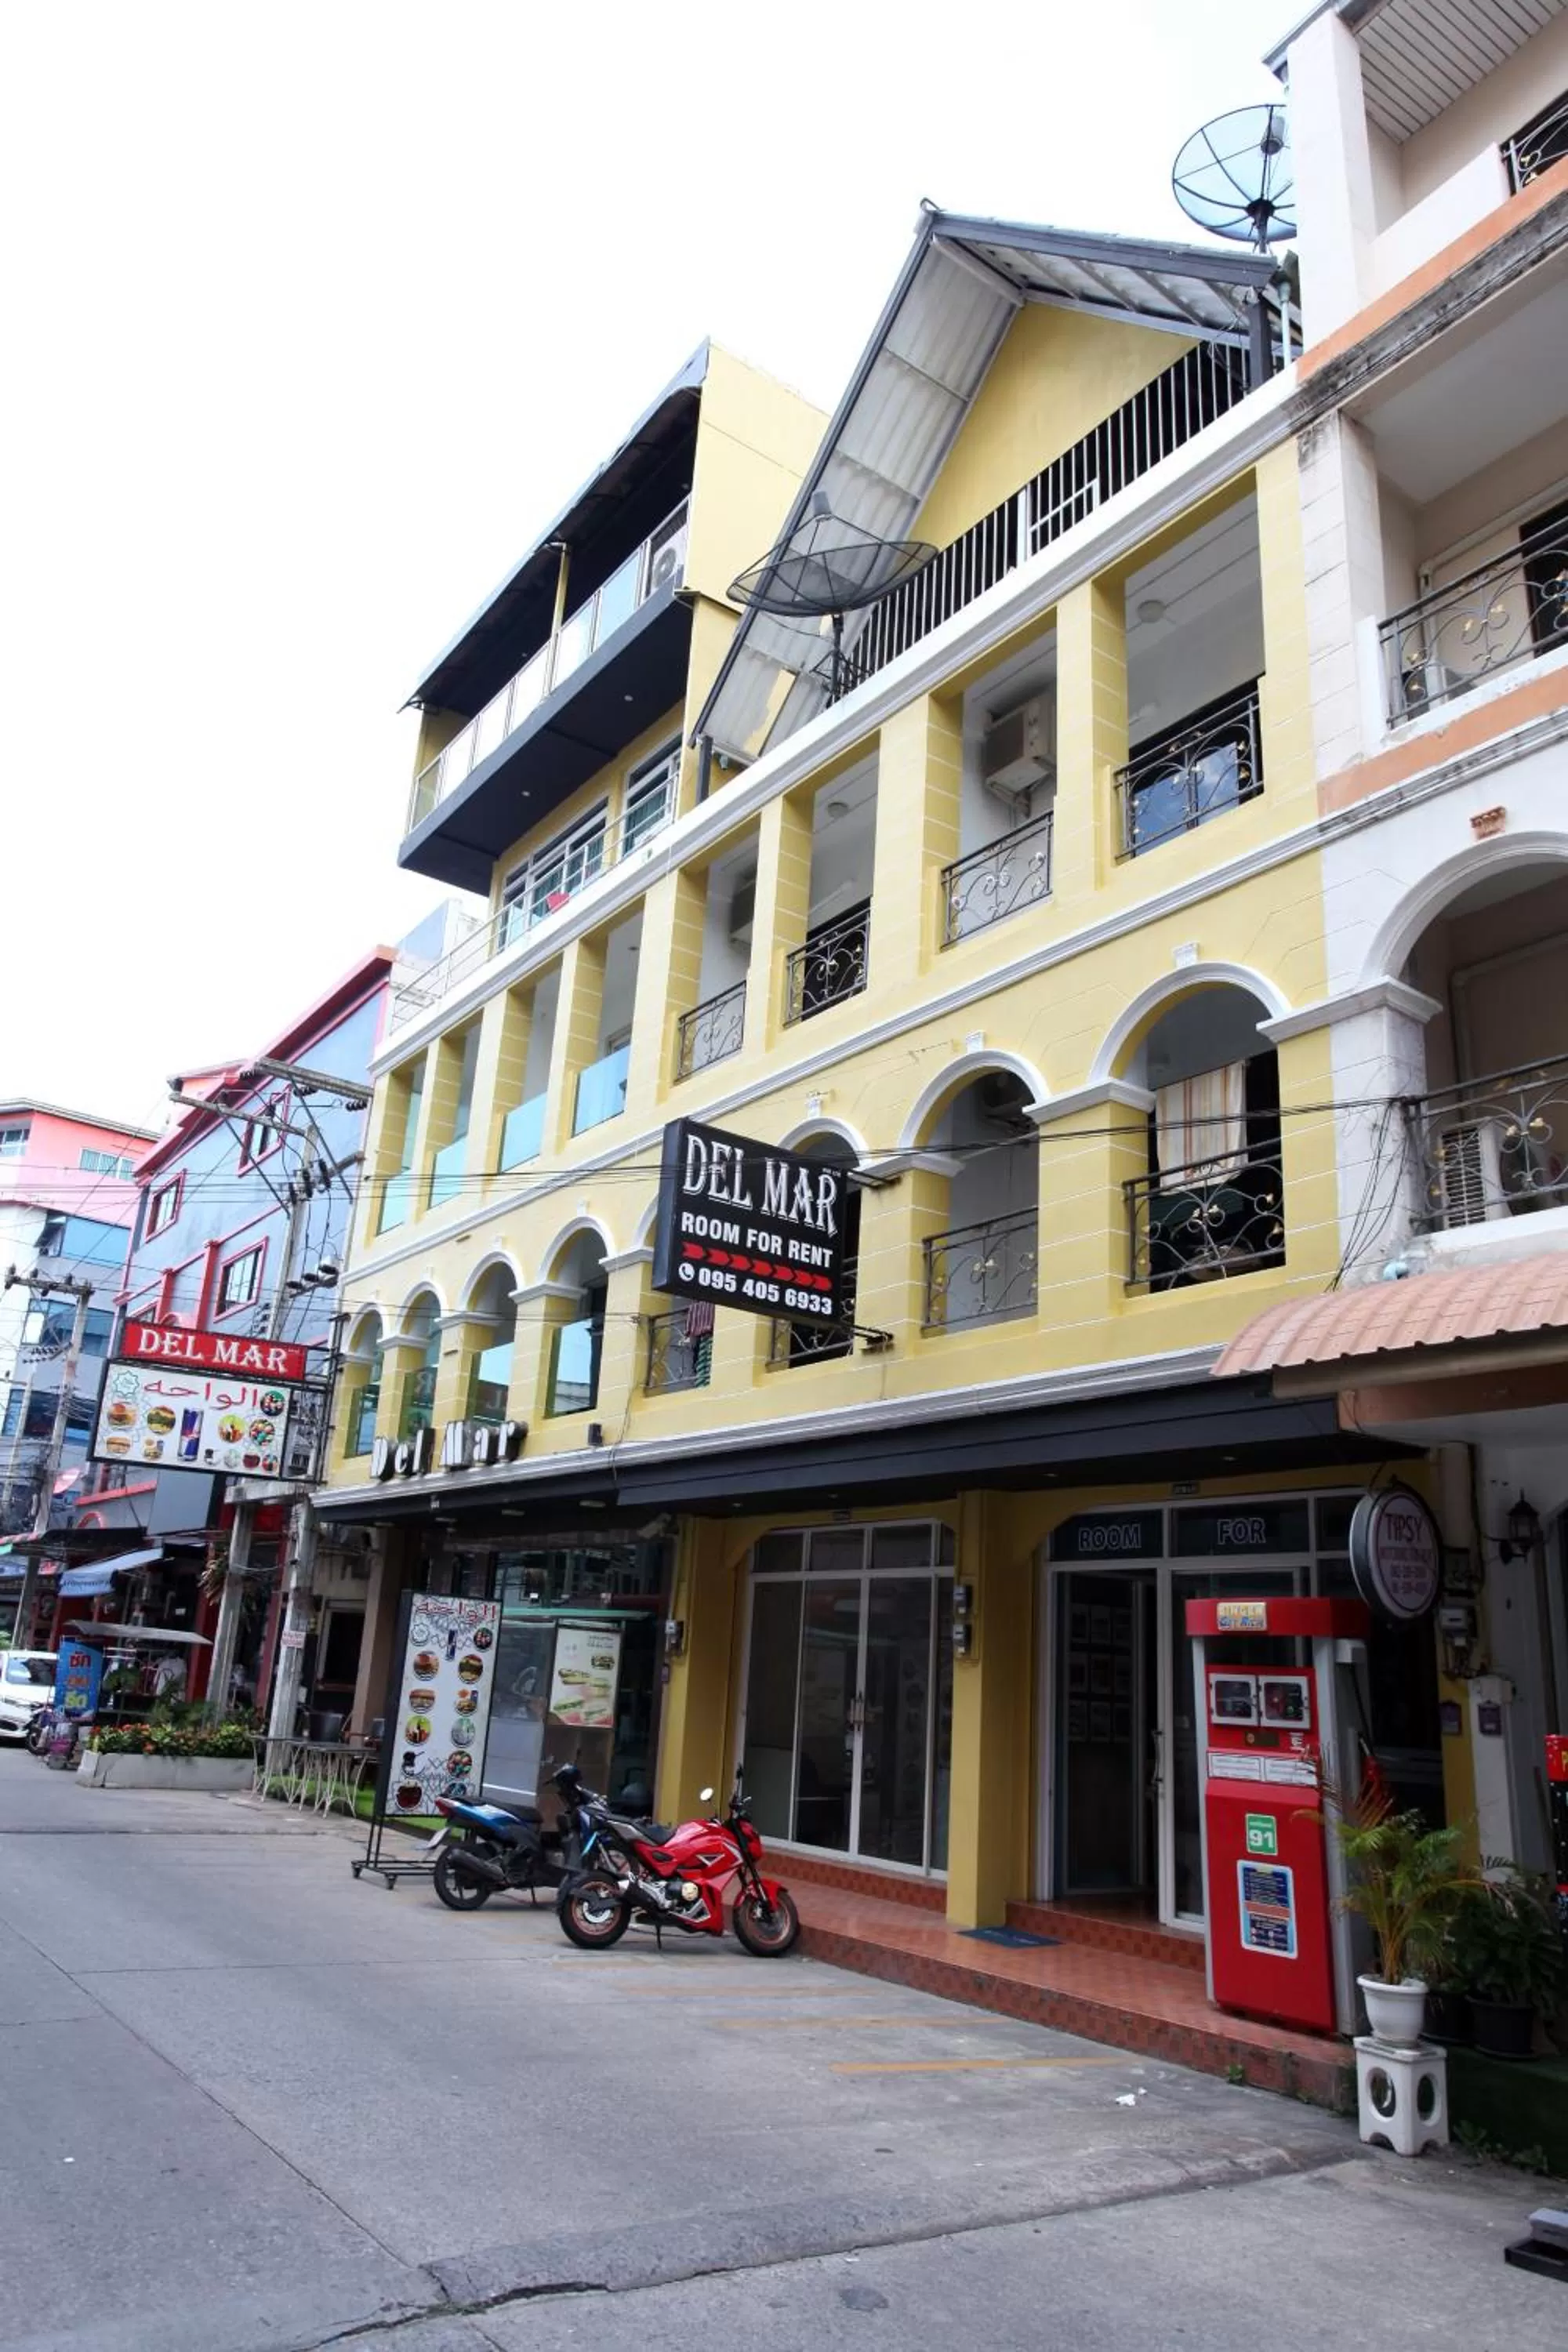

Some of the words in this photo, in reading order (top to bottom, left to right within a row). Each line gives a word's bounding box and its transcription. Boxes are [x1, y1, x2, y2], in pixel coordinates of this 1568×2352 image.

[683, 1134, 753, 1210] DEL
[760, 1157, 838, 1237] MAR
[681, 1211, 740, 1245] ROOM
[746, 1229, 782, 1256] FOR
[788, 1240, 833, 1268] RENT
[699, 1267, 737, 1292] 095
[742, 1279, 780, 1302] 405
[785, 1288, 833, 1316] 6933
[138, 1328, 204, 1360] DEL
[211, 1339, 289, 1373] MAR
[370, 1428, 430, 1479] Del
[438, 1421, 522, 1467] Mar
[1078, 1523, 1142, 1552] ROOM
[1217, 1517, 1267, 1545] FOR
[1249, 1829, 1274, 1849] 91
